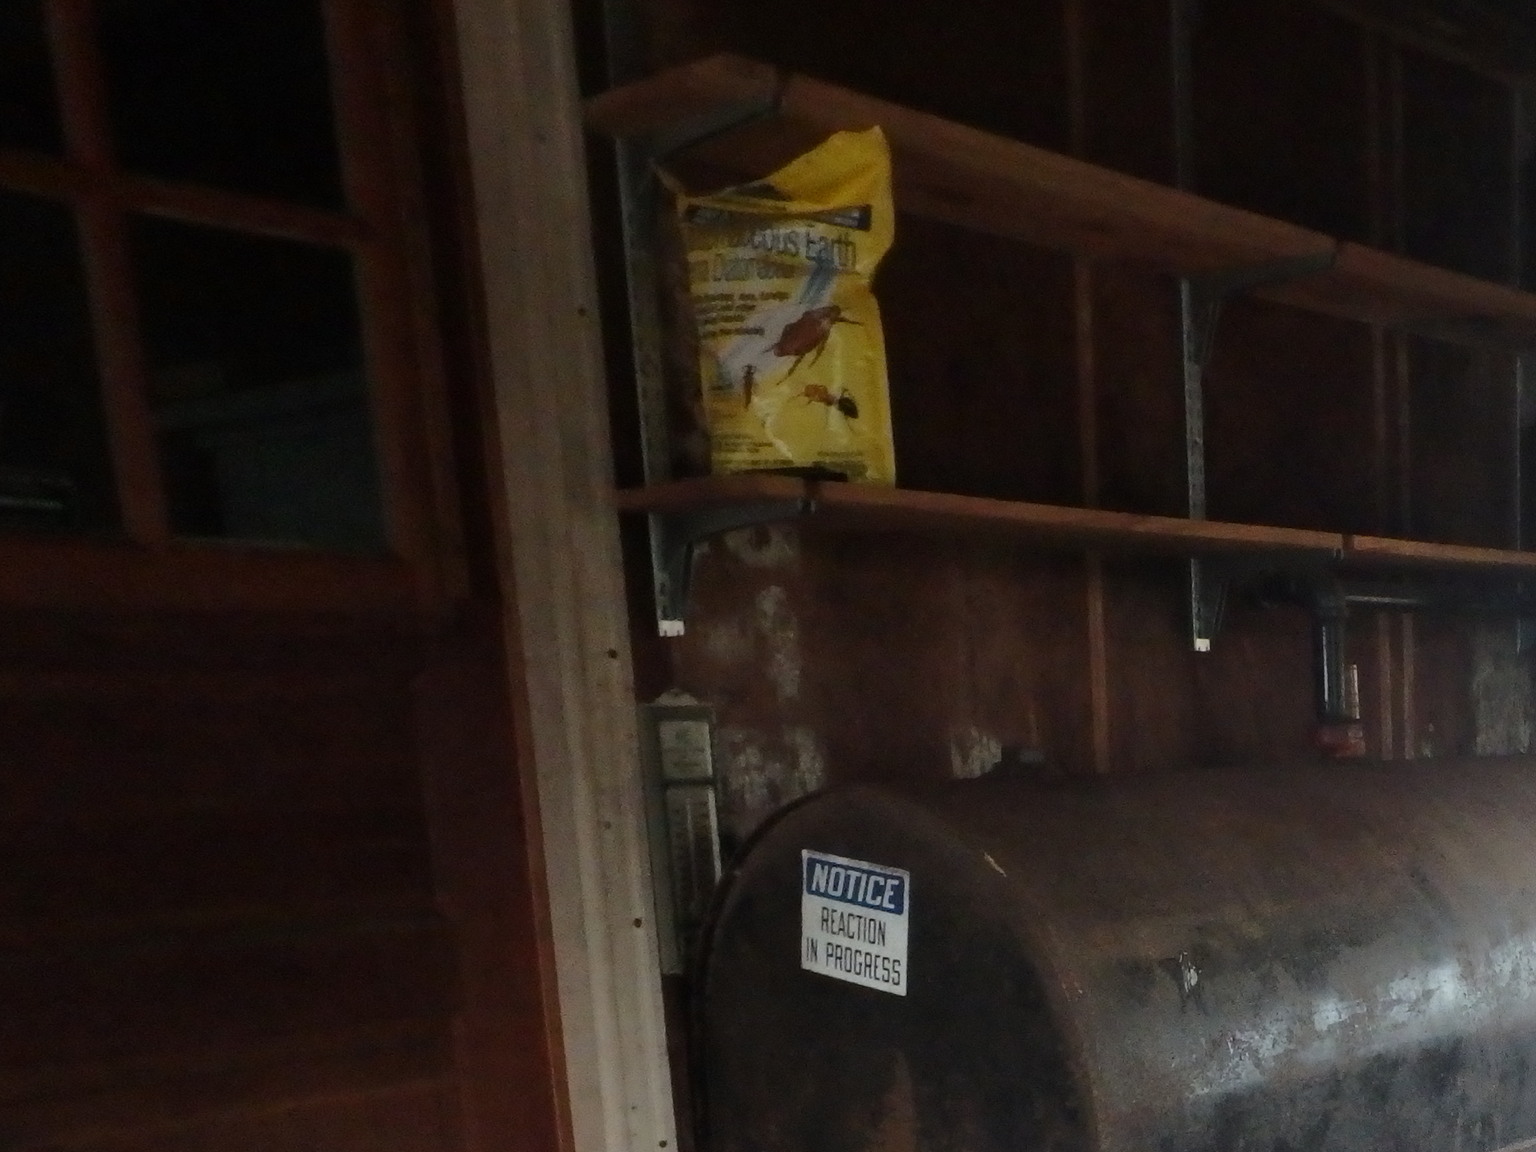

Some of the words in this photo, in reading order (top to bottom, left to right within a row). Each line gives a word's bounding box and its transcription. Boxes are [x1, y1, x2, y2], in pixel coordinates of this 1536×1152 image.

[811, 862, 899, 910] NOTICE
[821, 906, 886, 947] REACTION
[806, 937, 819, 964] IN
[826, 942, 901, 986] PROGRESS
